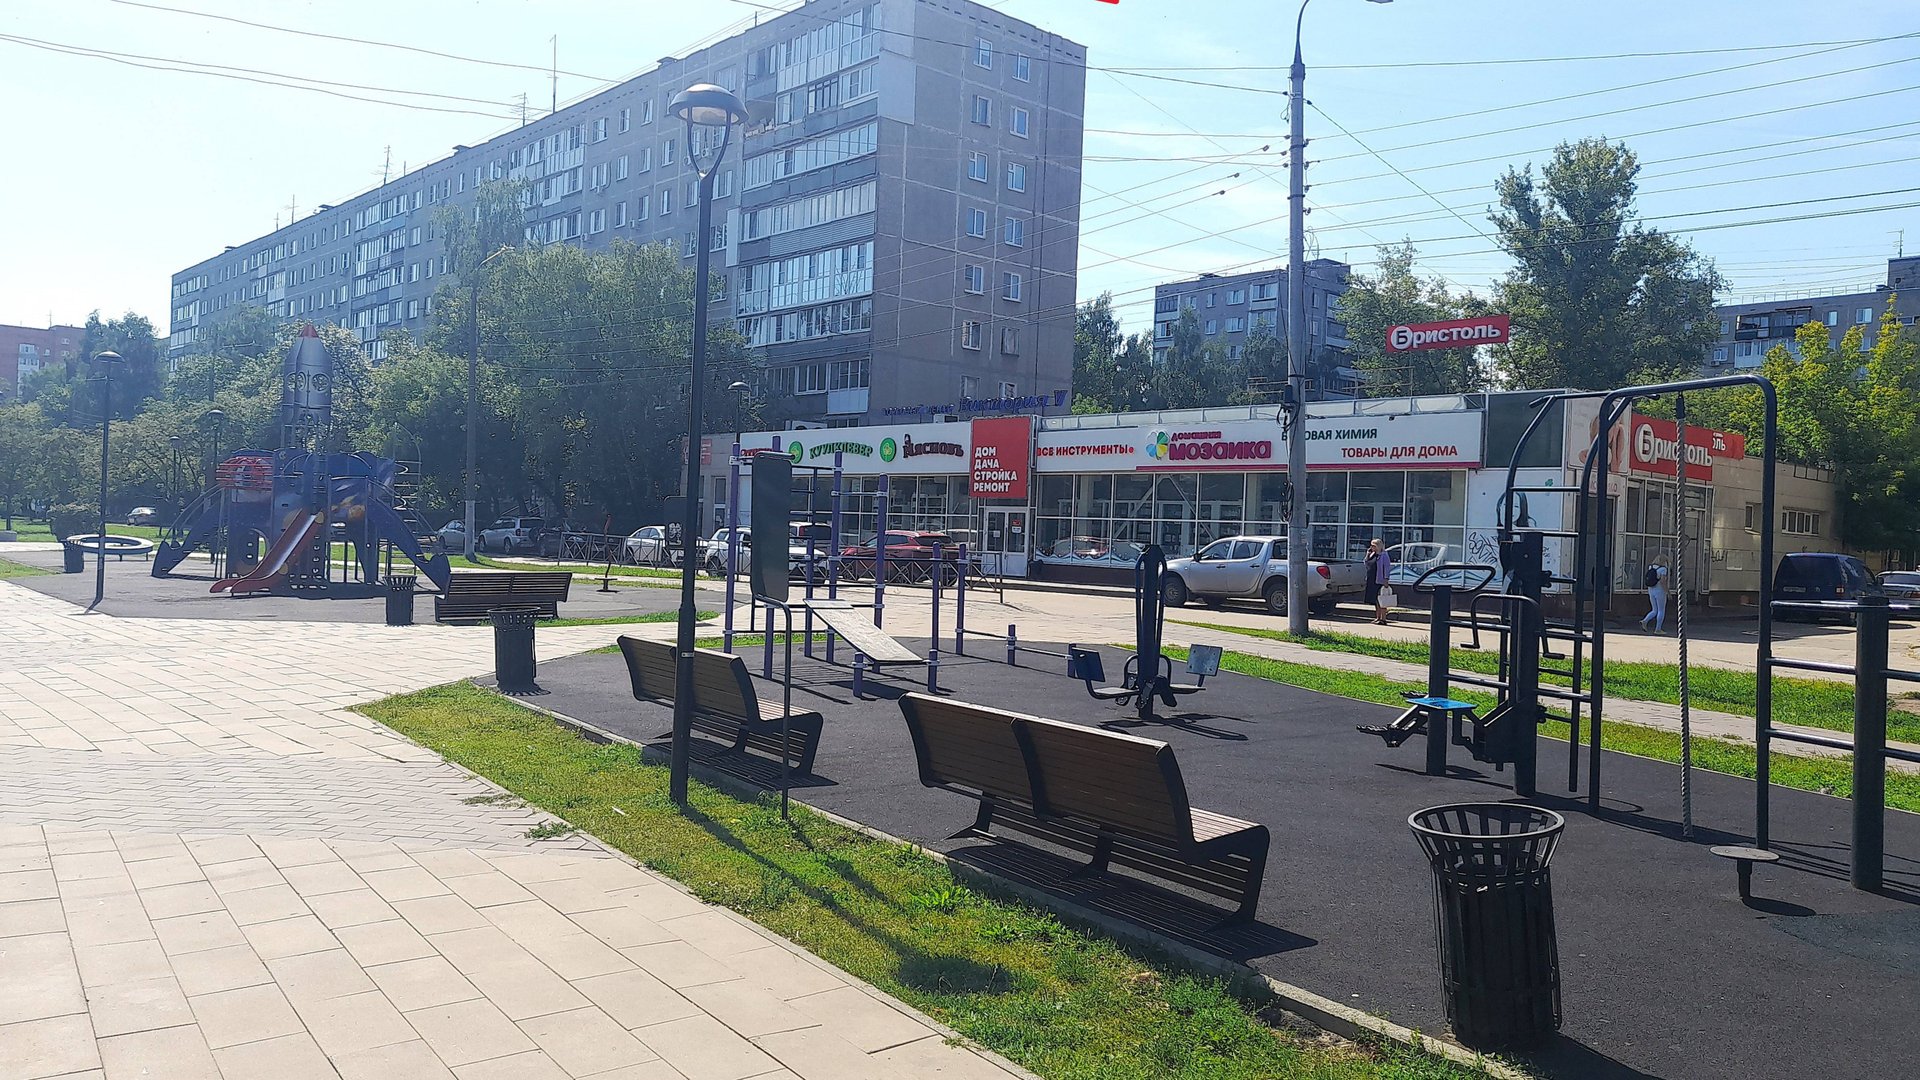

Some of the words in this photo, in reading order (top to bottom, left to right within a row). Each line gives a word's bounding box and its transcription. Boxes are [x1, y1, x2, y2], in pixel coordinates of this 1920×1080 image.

[1390, 325, 1501, 350] Бристоль
[1281, 429, 1332, 441] БОВАЯ
[1335, 428, 1377, 440] ХИМИЯ
[975, 447, 996, 458] ДОМ
[1341, 447, 1387, 458] ТОВАРЫ
[1390, 446, 1415, 459] ДЛЯ
[1418, 445, 1457, 459] ДОМА
[974, 459, 999, 470] ДАЧА
[974, 469, 1017, 481] СТРОЙКА
[973, 482, 1010, 492] РЕМОНТ
